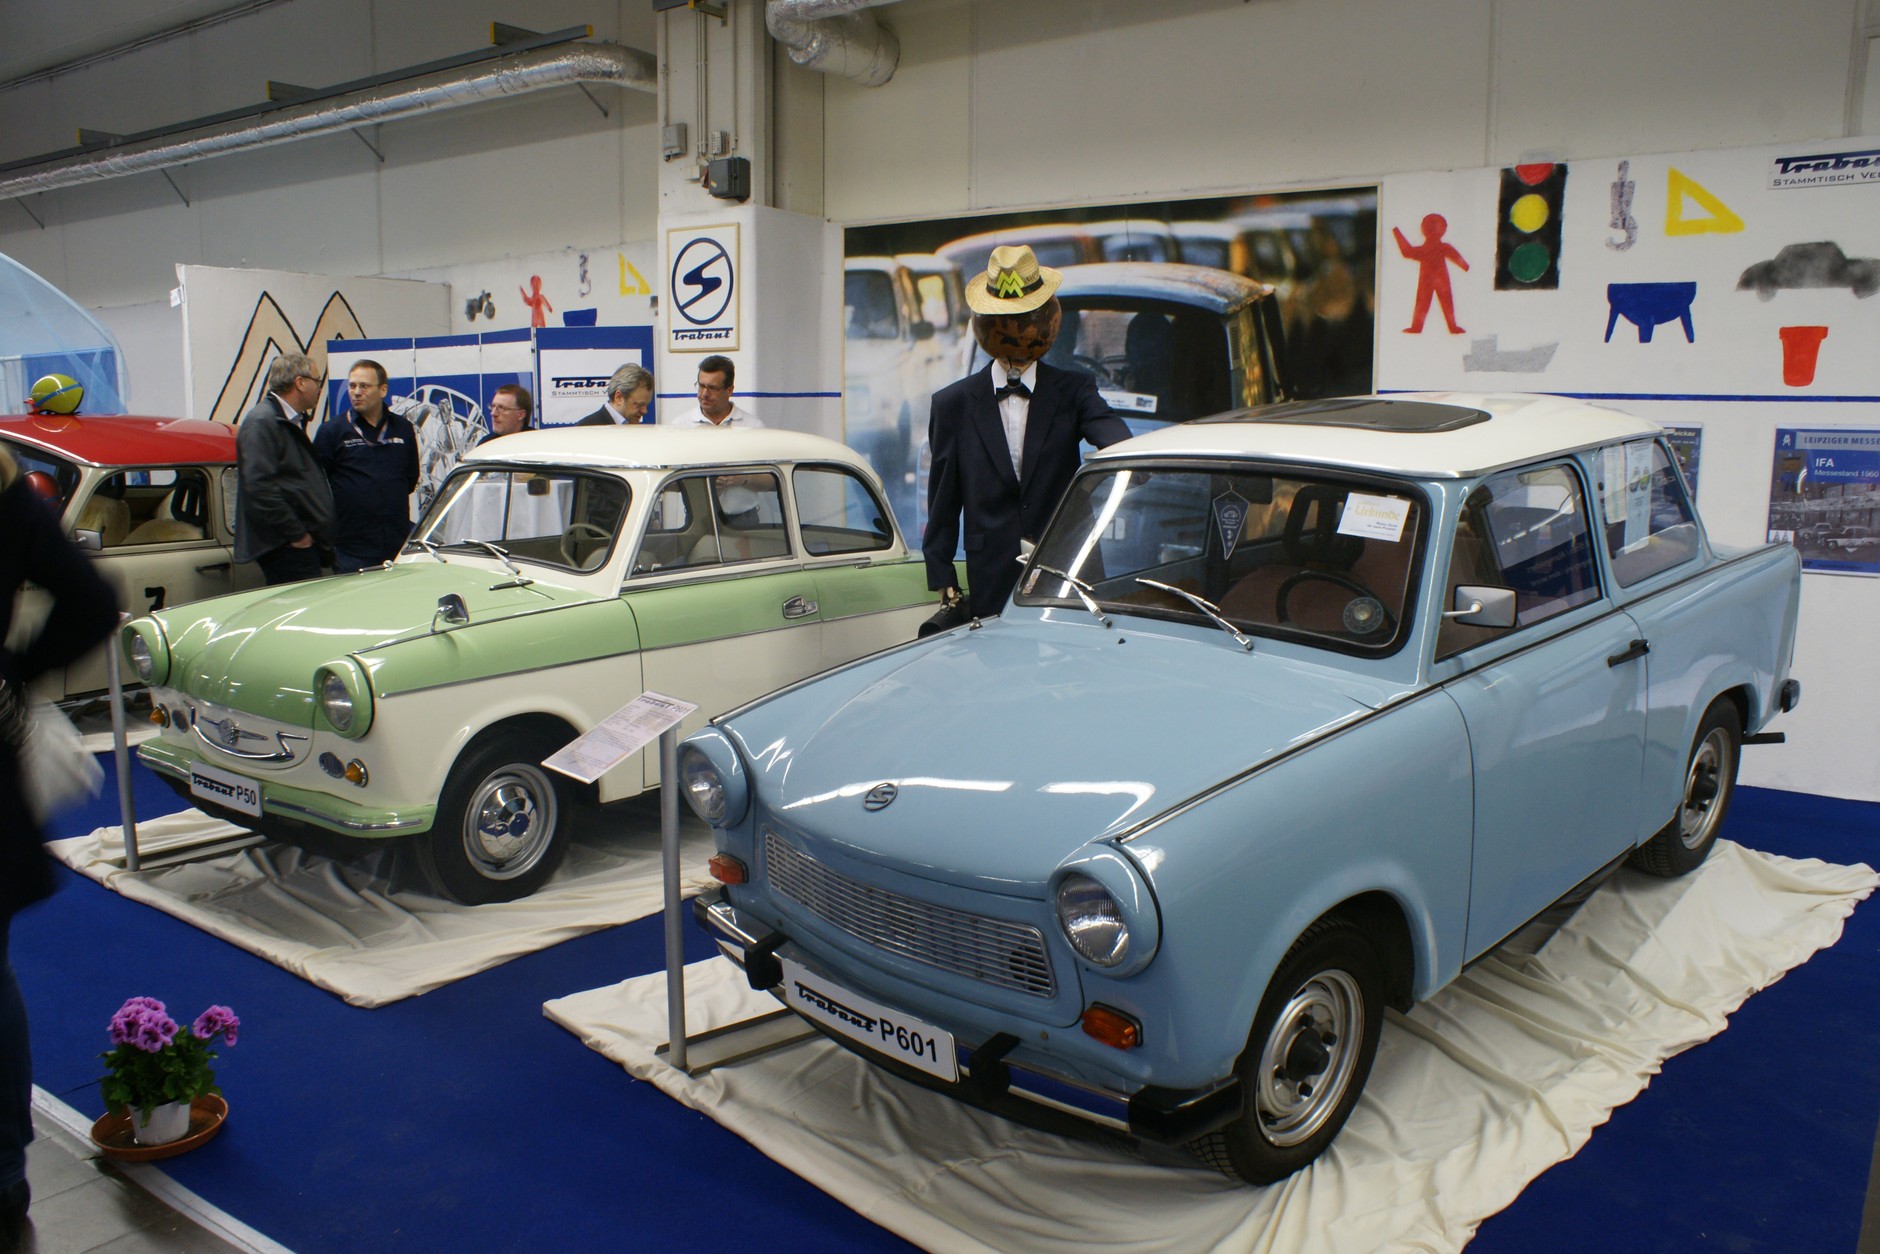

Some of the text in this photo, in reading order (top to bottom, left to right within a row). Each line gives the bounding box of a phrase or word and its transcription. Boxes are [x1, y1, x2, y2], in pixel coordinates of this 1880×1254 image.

[1773, 174, 1855, 187] STAMMTISCH
[672, 327, 734, 341] Trabant
[551, 376, 612, 389] Traba
[1804, 436, 1880, 446] LEIPZIGER MESSE
[1815, 457, 1835, 468] IFA
[1814, 469, 1880, 479] Messestand 1960
[1355, 503, 1400, 521] Urkunde
[191, 772, 257, 806] Trabant P50
[794, 980, 938, 1063] Trabant P601
